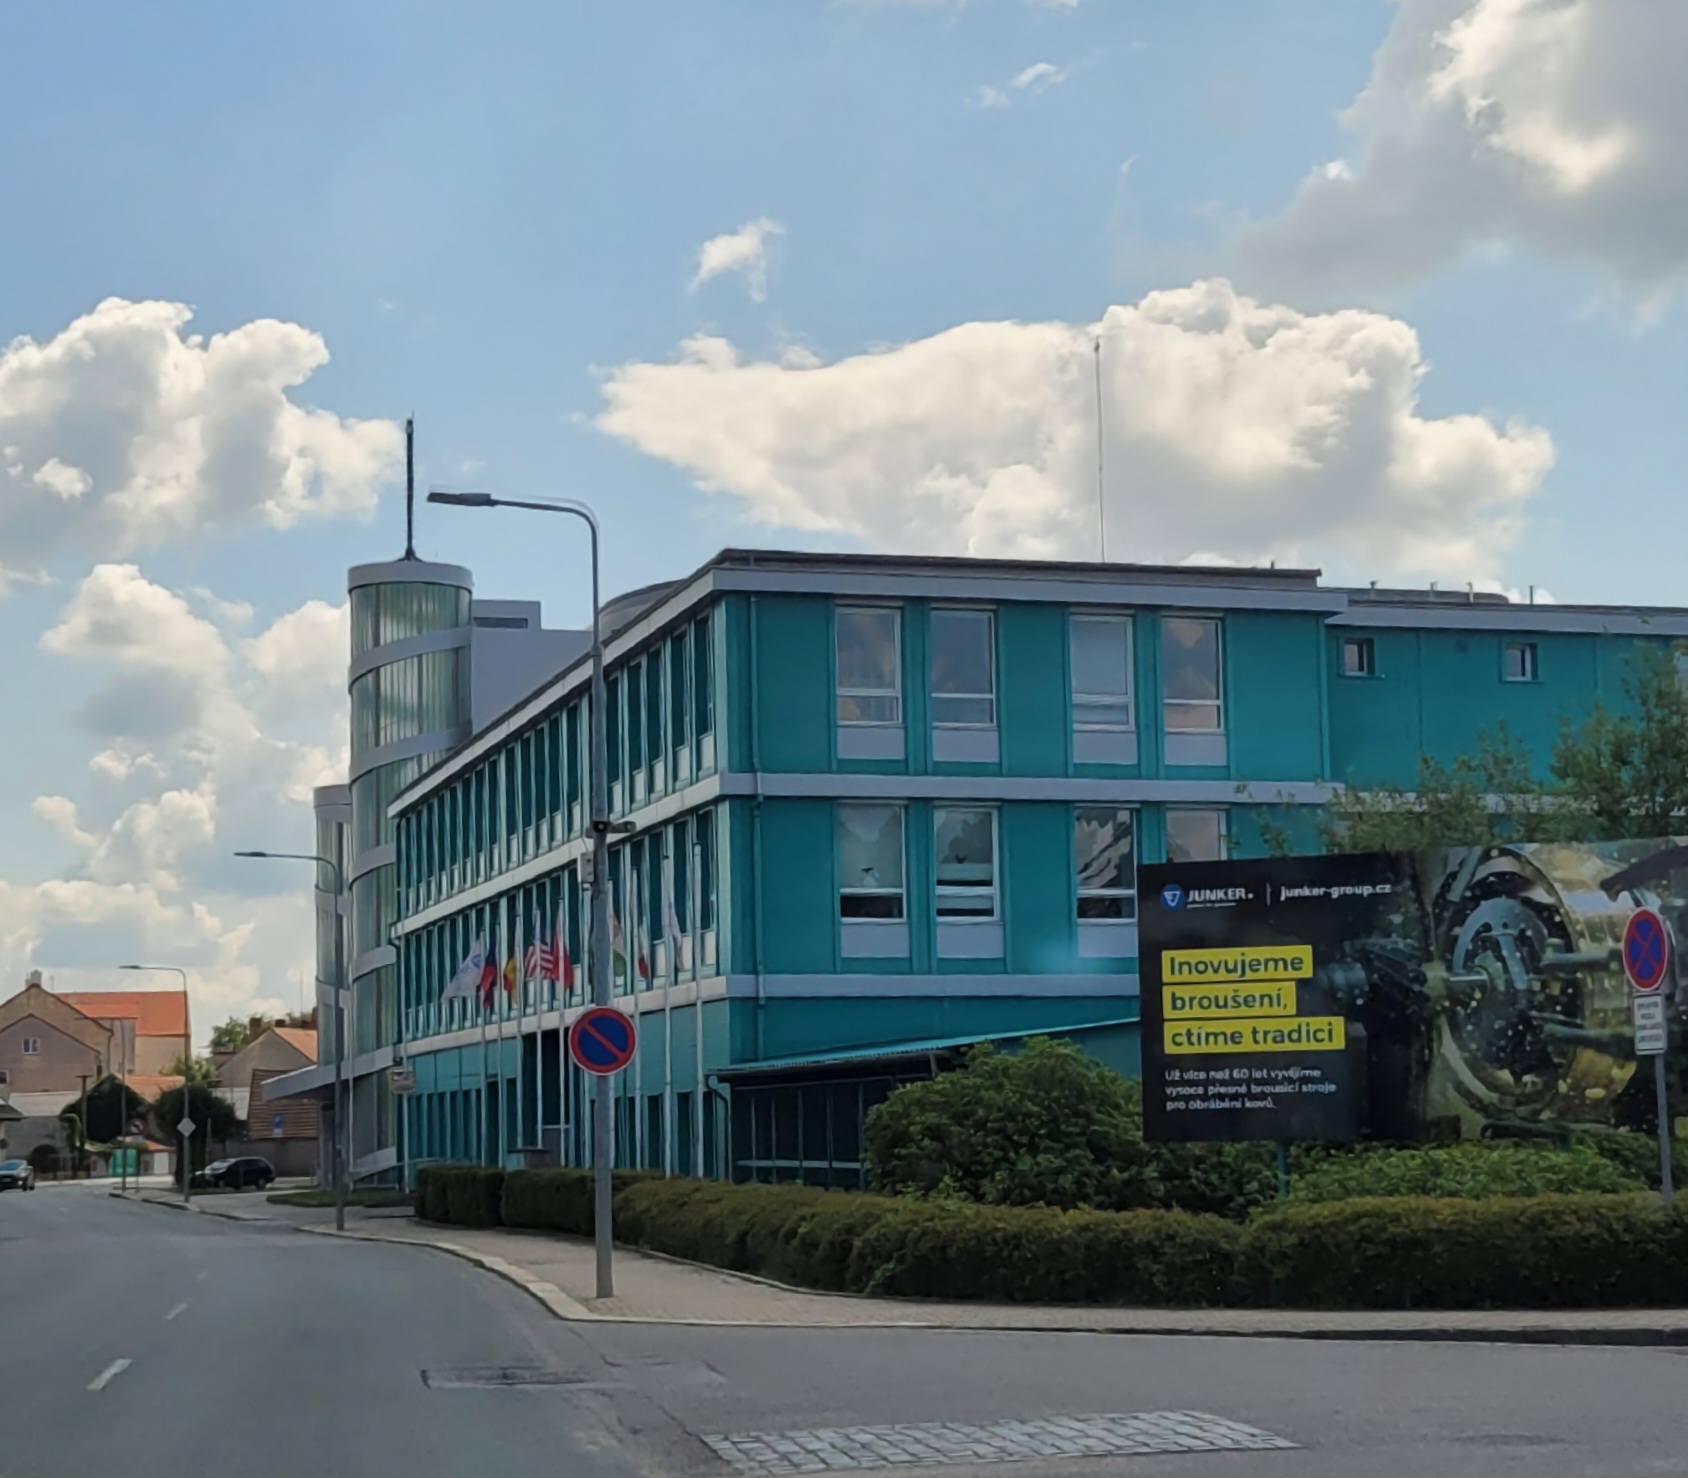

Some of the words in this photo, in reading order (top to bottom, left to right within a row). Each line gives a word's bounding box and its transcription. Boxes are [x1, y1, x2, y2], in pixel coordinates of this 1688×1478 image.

[1279, 884, 1392, 901] junker-group.cz
[1169, 952, 1304, 978] Inovujeme
[1170, 987, 1288, 1011] broušení,
[1171, 1025, 1244, 1046] ctíme
[1251, 1021, 1334, 1045] tradici
[1165, 1068, 1181, 1081] Už
[1233, 1068, 1249, 1079] 60
[1251, 1067, 1268, 1079] let
[1165, 1085, 1204, 1097] vysoce
[1301, 1081, 1337, 1094] stroje
[1165, 1100, 1186, 1112] pro
